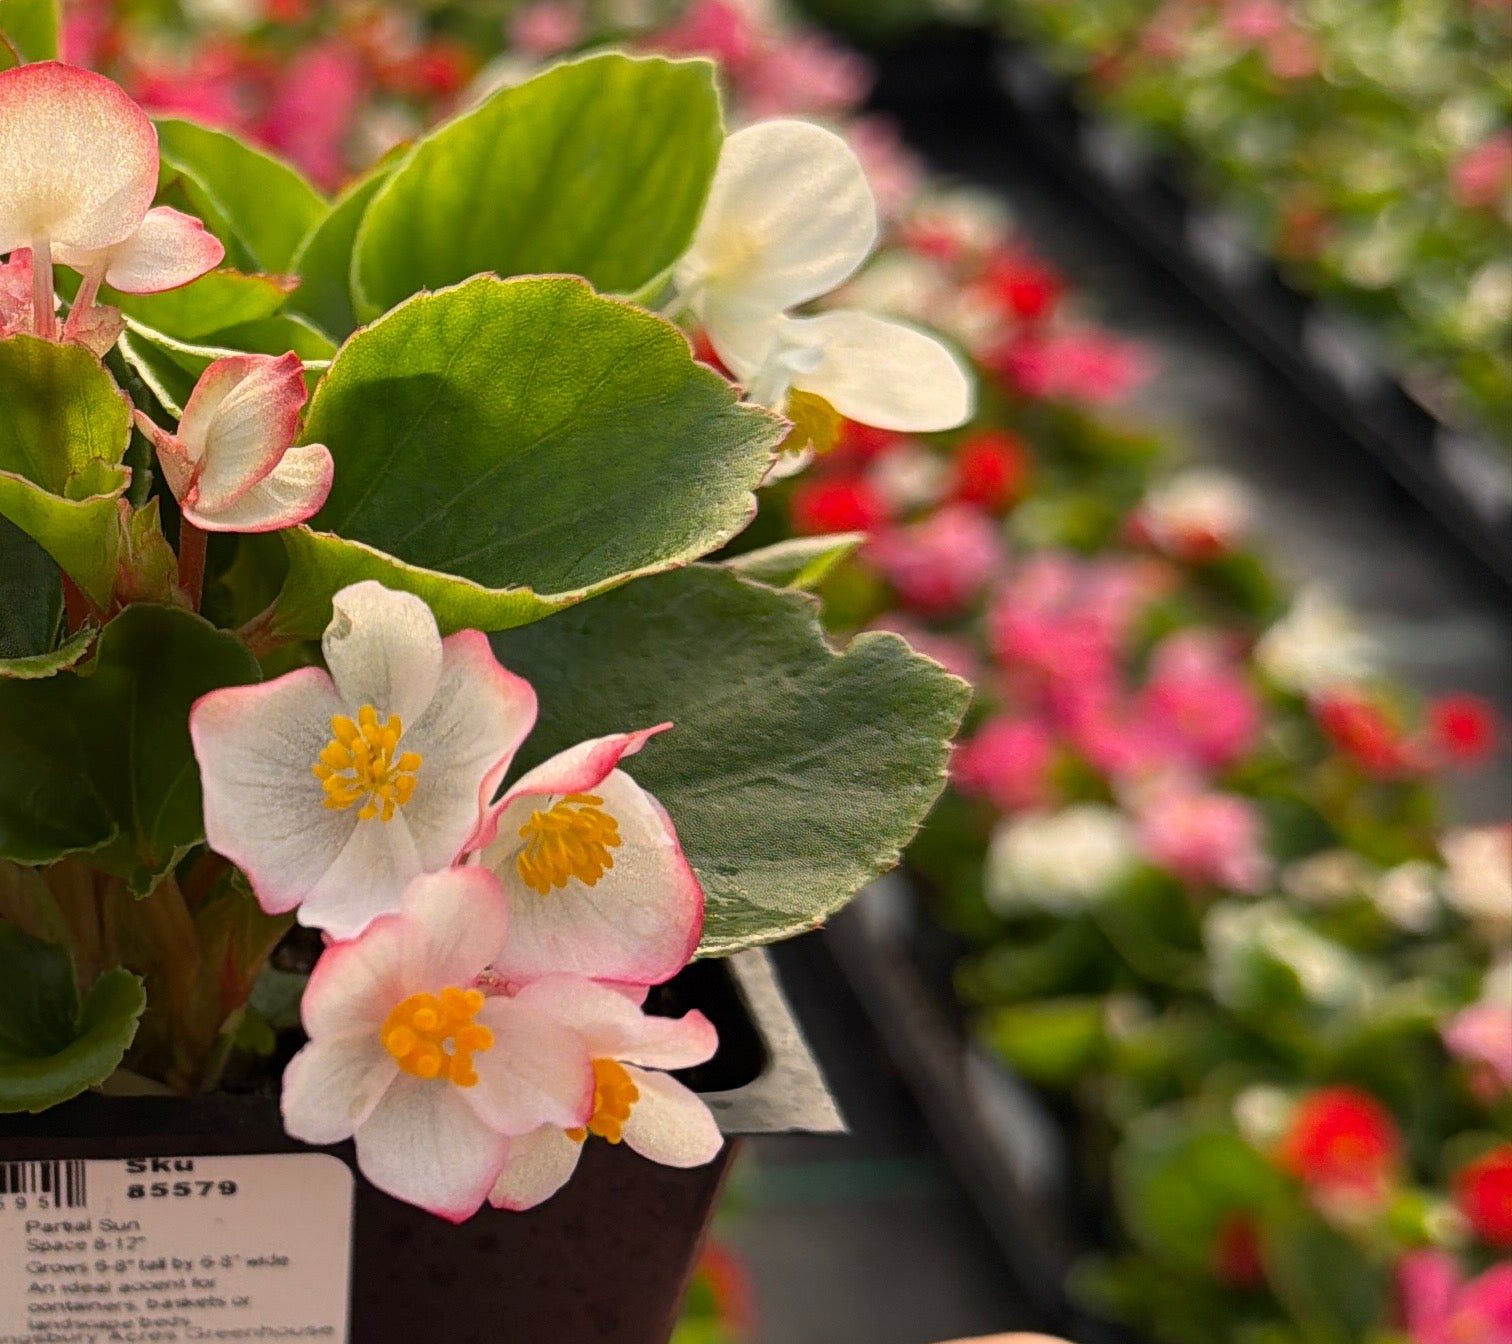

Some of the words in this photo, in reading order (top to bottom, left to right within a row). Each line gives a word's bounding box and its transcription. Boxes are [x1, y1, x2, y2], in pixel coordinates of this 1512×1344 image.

[125, 1157, 194, 1173] Sku
[127, 1180, 237, 1199] 85579
[26, 1219, 92, 1233] Partial
[99, 1218, 140, 1232] Sun
[26, 1239, 87, 1253] Space
[26, 1260, 88, 1274] Grows
[172, 1257, 193, 1272] by
[27, 1281, 56, 1294] An
[192, 1276, 216, 1290] for
